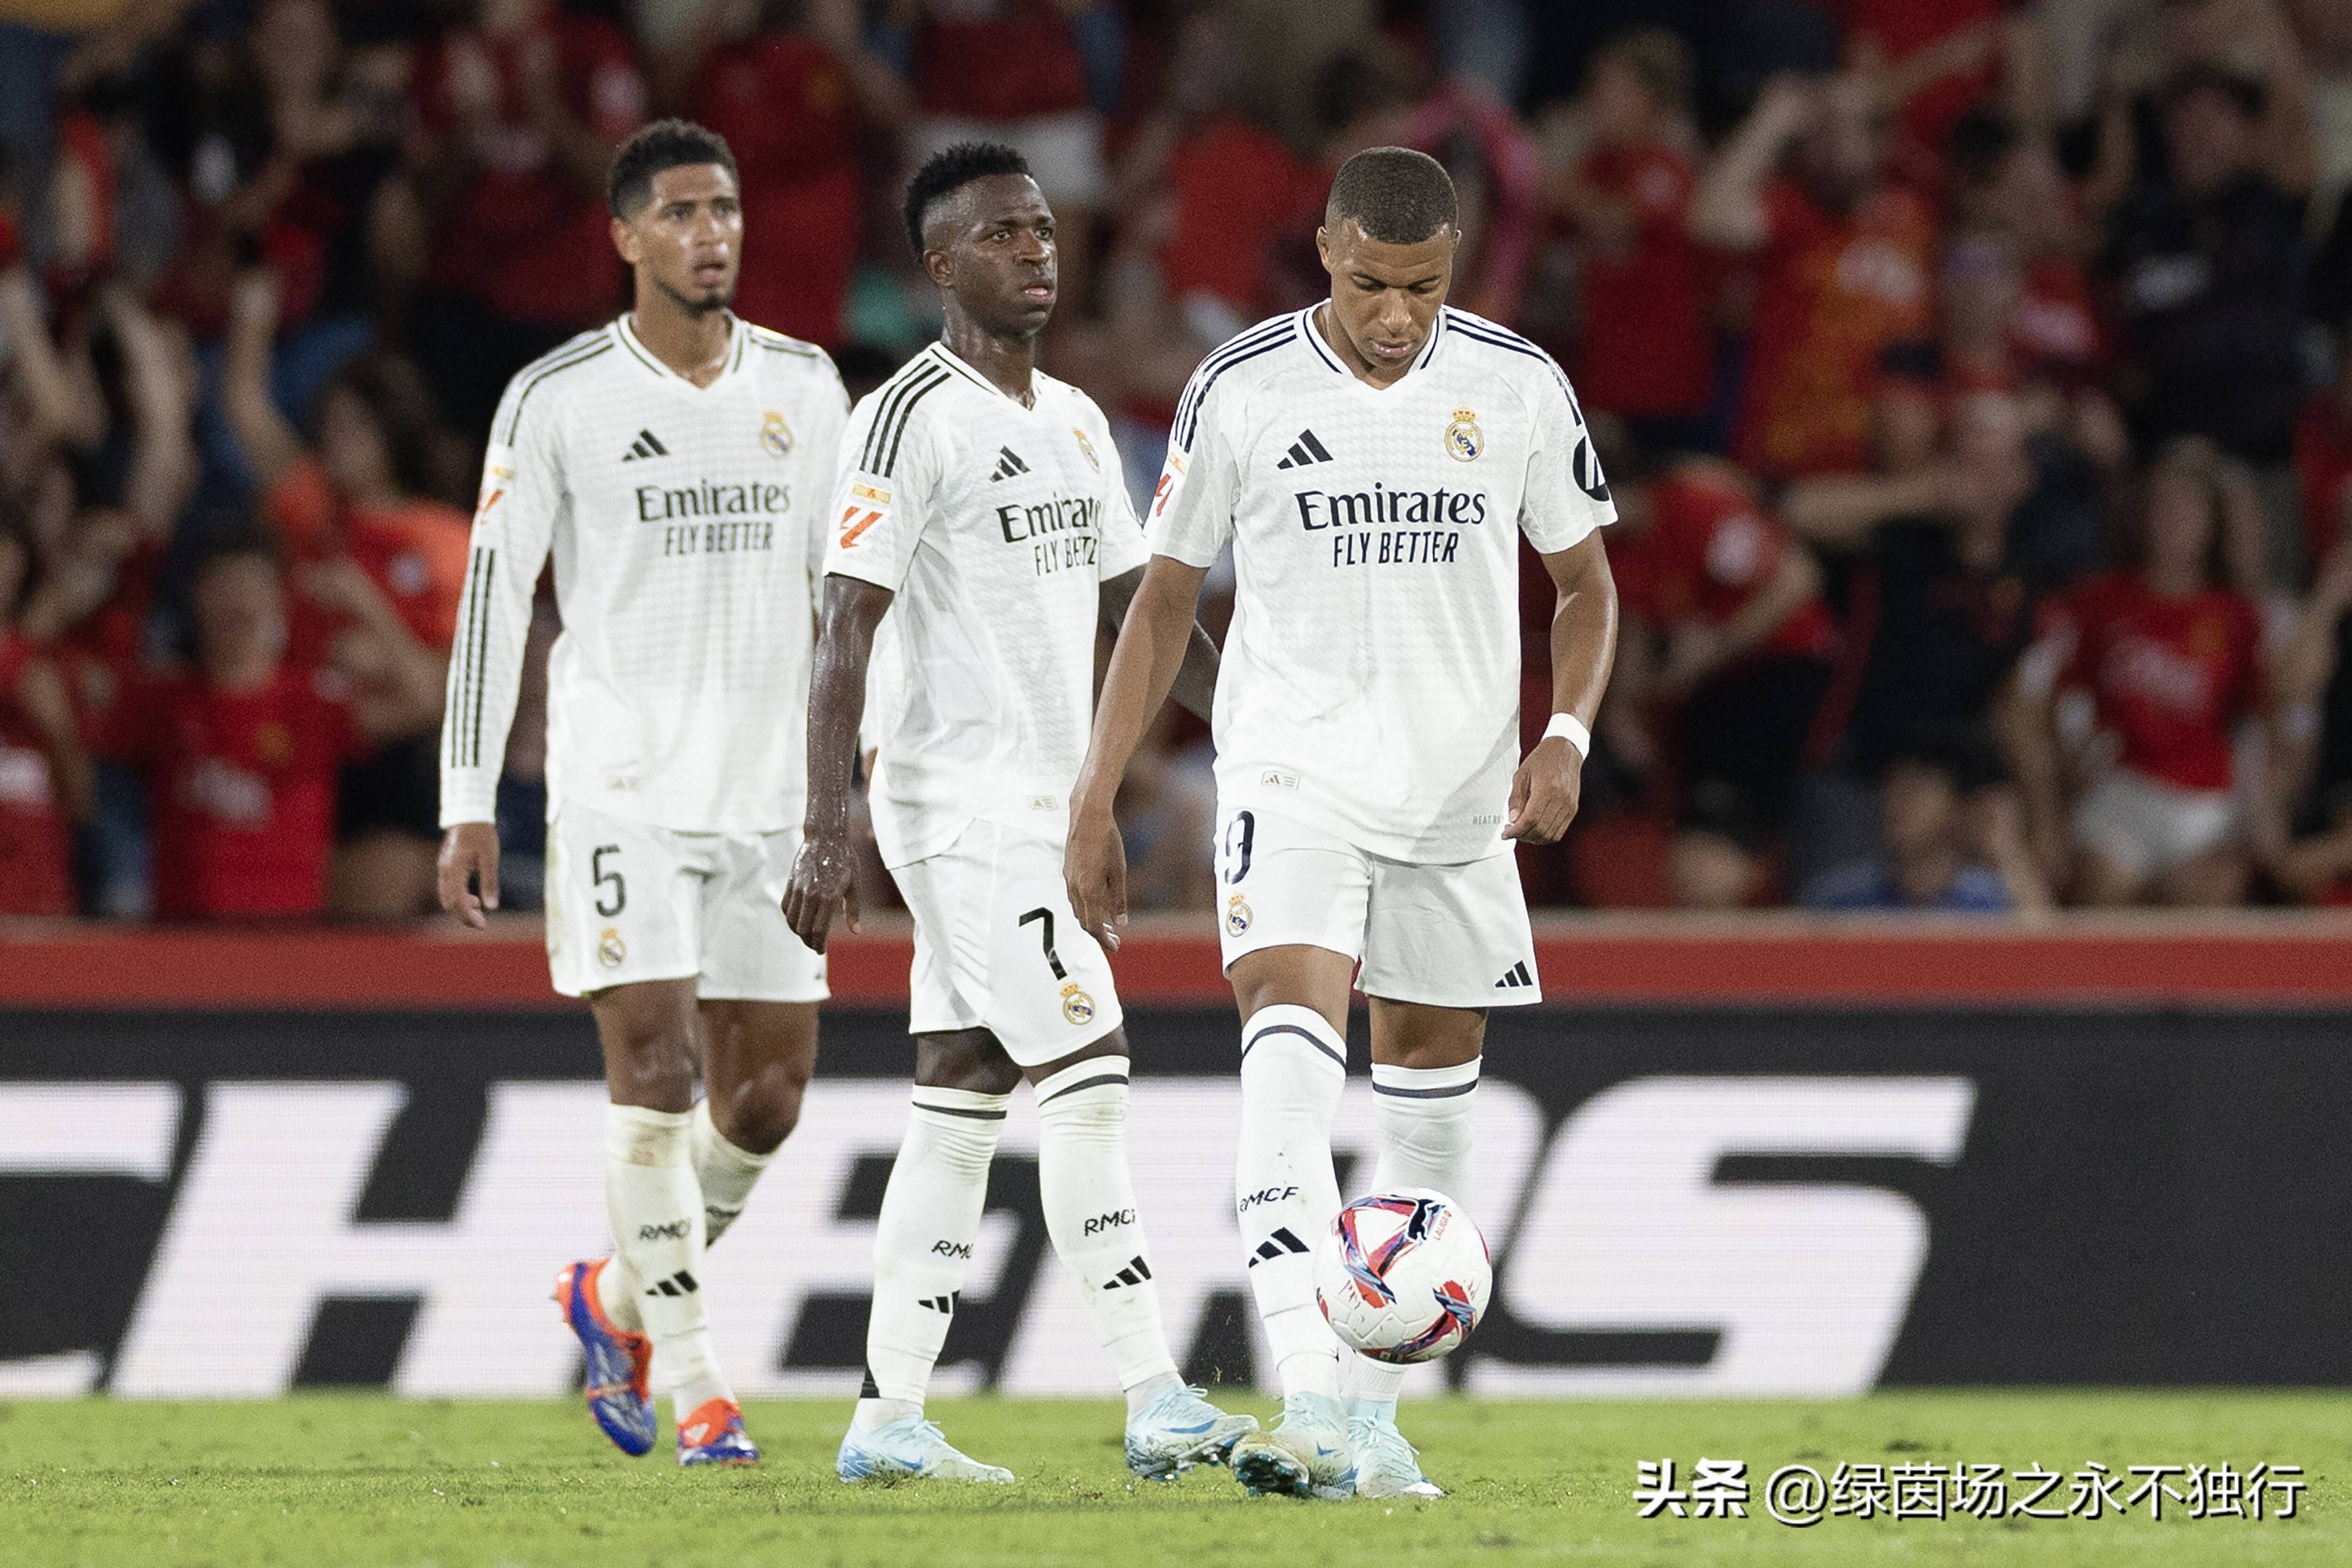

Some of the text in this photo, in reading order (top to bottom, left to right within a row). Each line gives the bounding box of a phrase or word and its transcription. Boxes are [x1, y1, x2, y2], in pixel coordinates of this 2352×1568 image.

[636, 479, 791, 522] Emirates
[995, 490, 1102, 543] Emirate
[1294, 482, 1485, 530] Emirates
[665, 522, 774, 556] FLY BETTER
[1035, 540, 1058, 576] FLY
[1333, 531, 1459, 568] FLY BETTER
[591, 843, 626, 918] 5
[1019, 906, 1068, 981] 7
